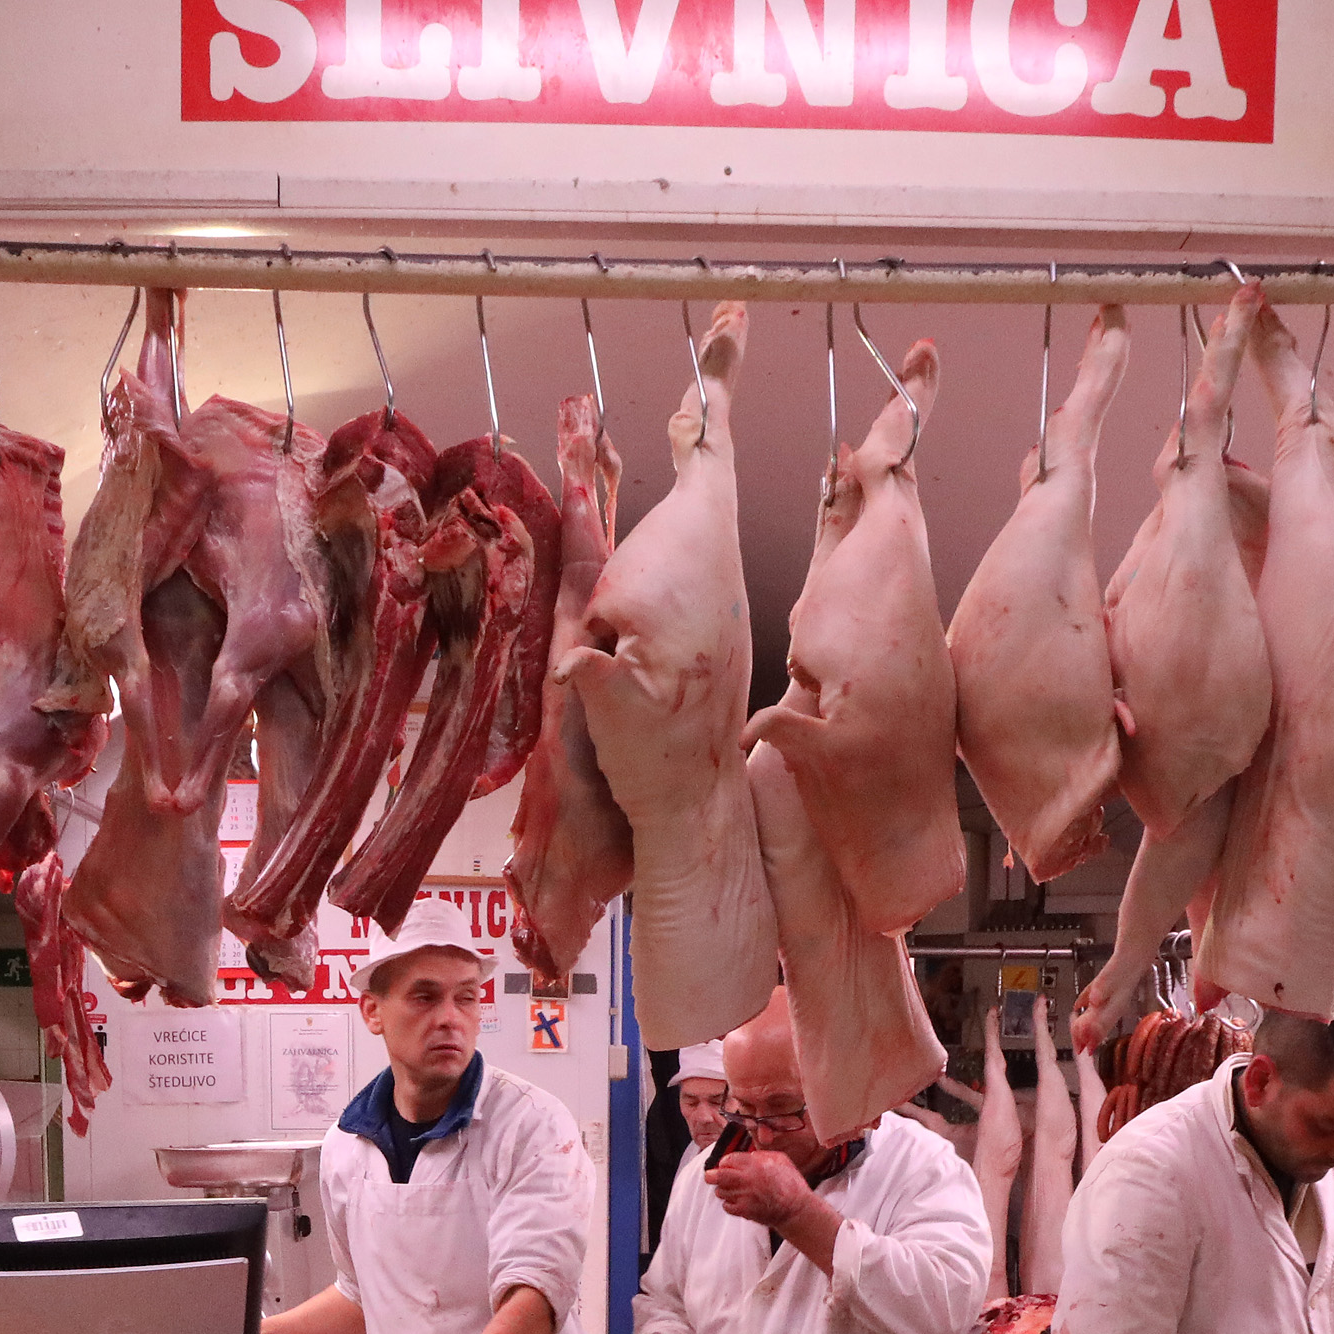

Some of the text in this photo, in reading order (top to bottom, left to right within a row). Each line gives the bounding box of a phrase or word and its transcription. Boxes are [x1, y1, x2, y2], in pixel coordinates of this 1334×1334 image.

[209, 0, 1248, 122] SLIVNICA
[153, 1027, 208, 1043] VREĆICE
[148, 1052, 215, 1066] KORISTITE
[148, 1073, 217, 1089] ŠTEDLJIVO
